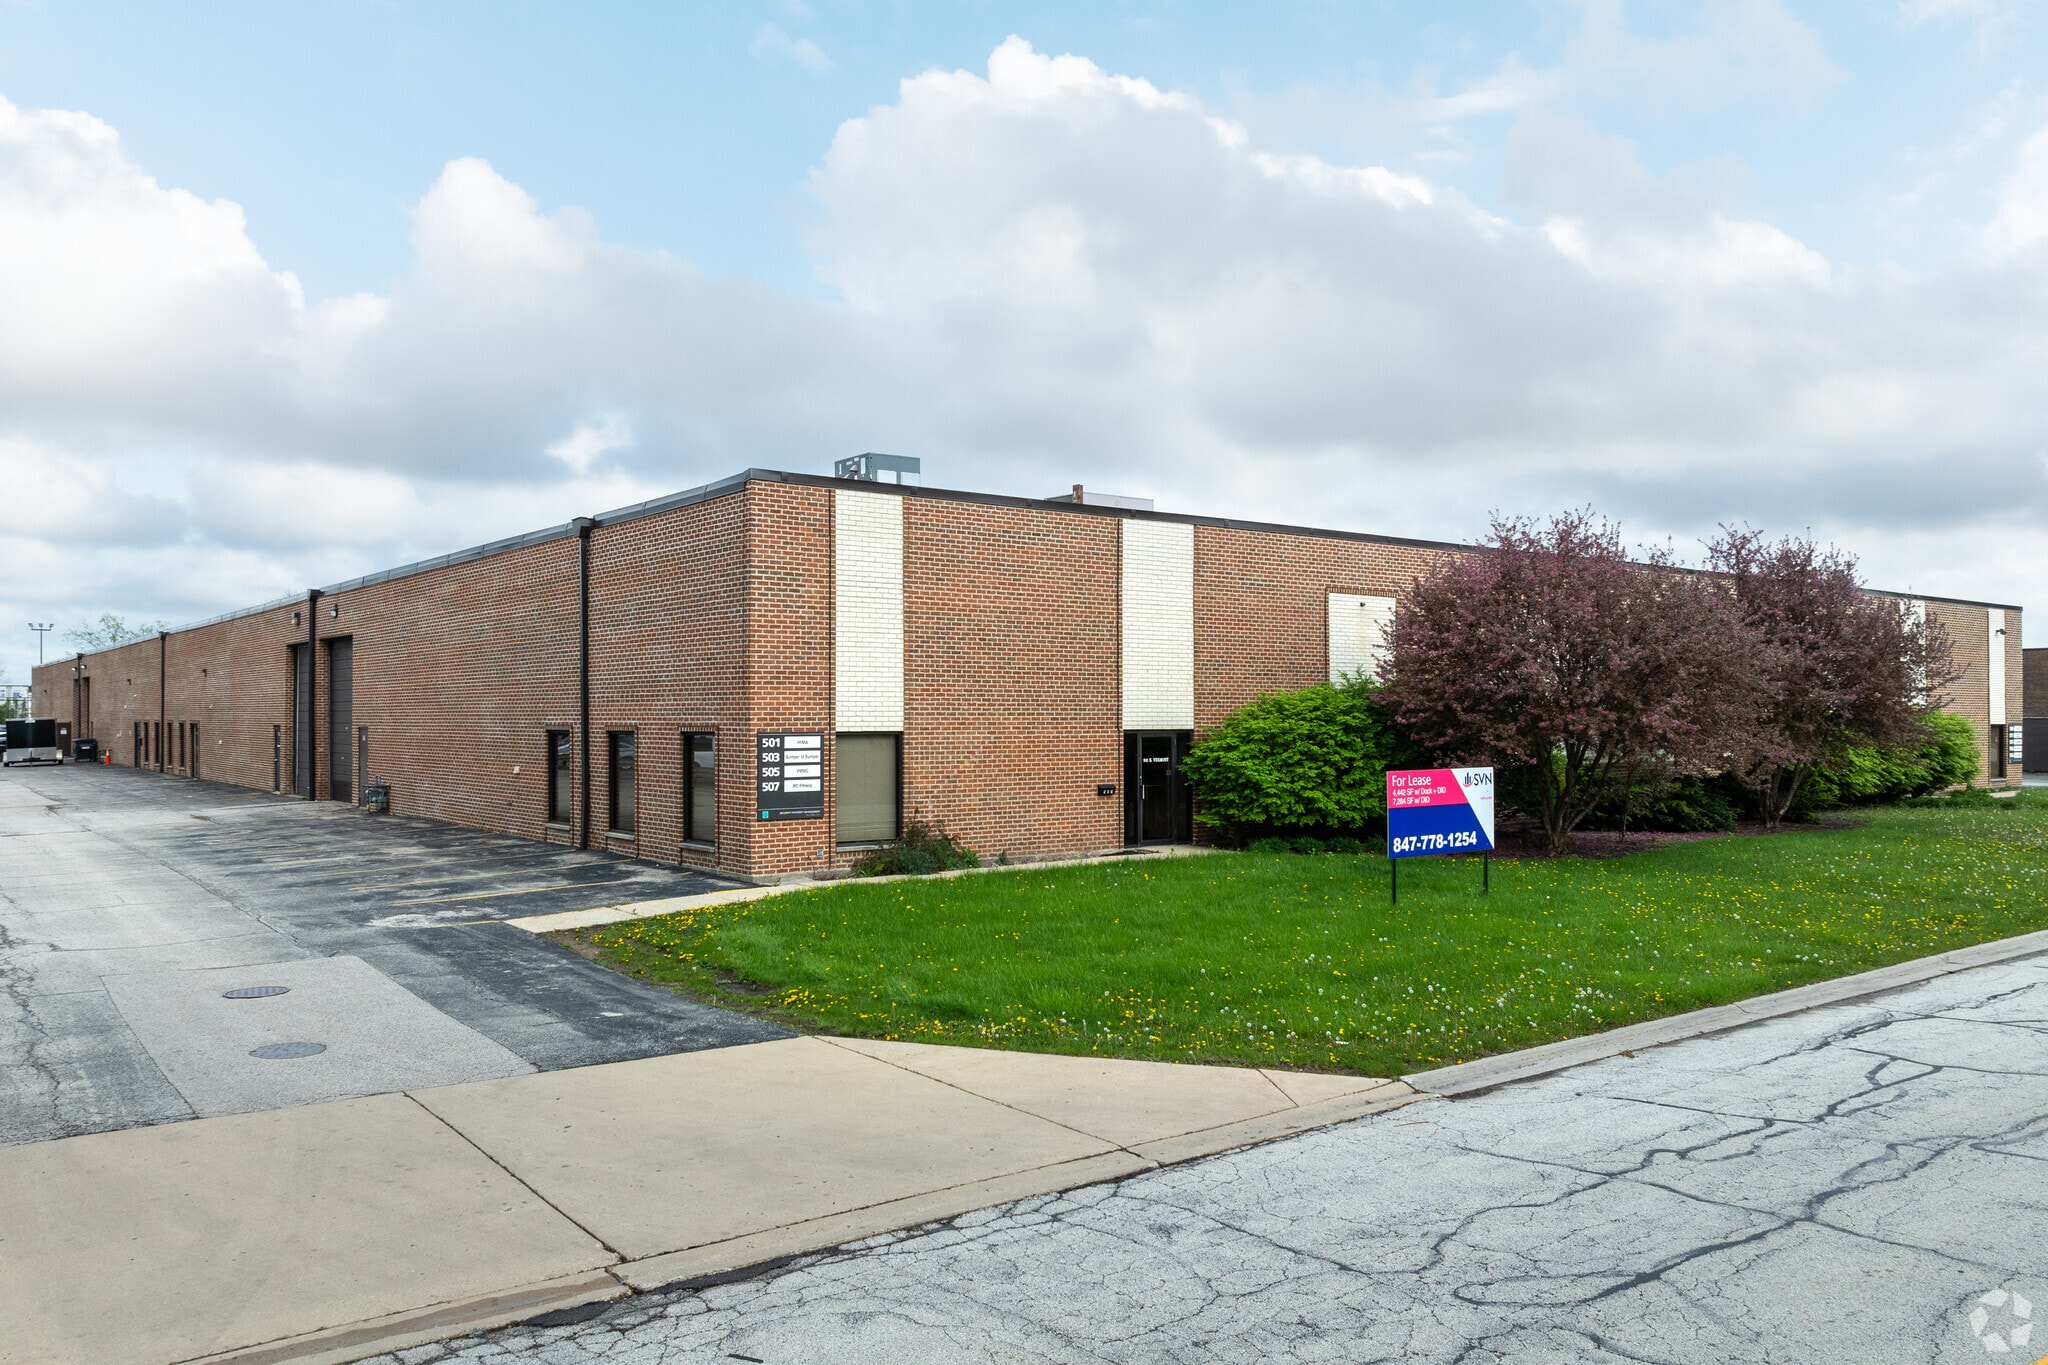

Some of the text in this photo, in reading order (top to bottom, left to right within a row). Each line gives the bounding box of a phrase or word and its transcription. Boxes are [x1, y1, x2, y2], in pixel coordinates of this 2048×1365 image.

[762, 738, 780, 748] 501
[762, 752, 780, 763] 503
[762, 767, 780, 777] 505
[1391, 774, 1431, 787] For Lease
[1473, 772, 1492, 786] SVN
[762, 781, 780, 792] 507
[1406, 788, 1414, 796] SF
[1420, 787, 1433, 795] Dock
[1392, 831, 1477, 853] 847-778-1254
